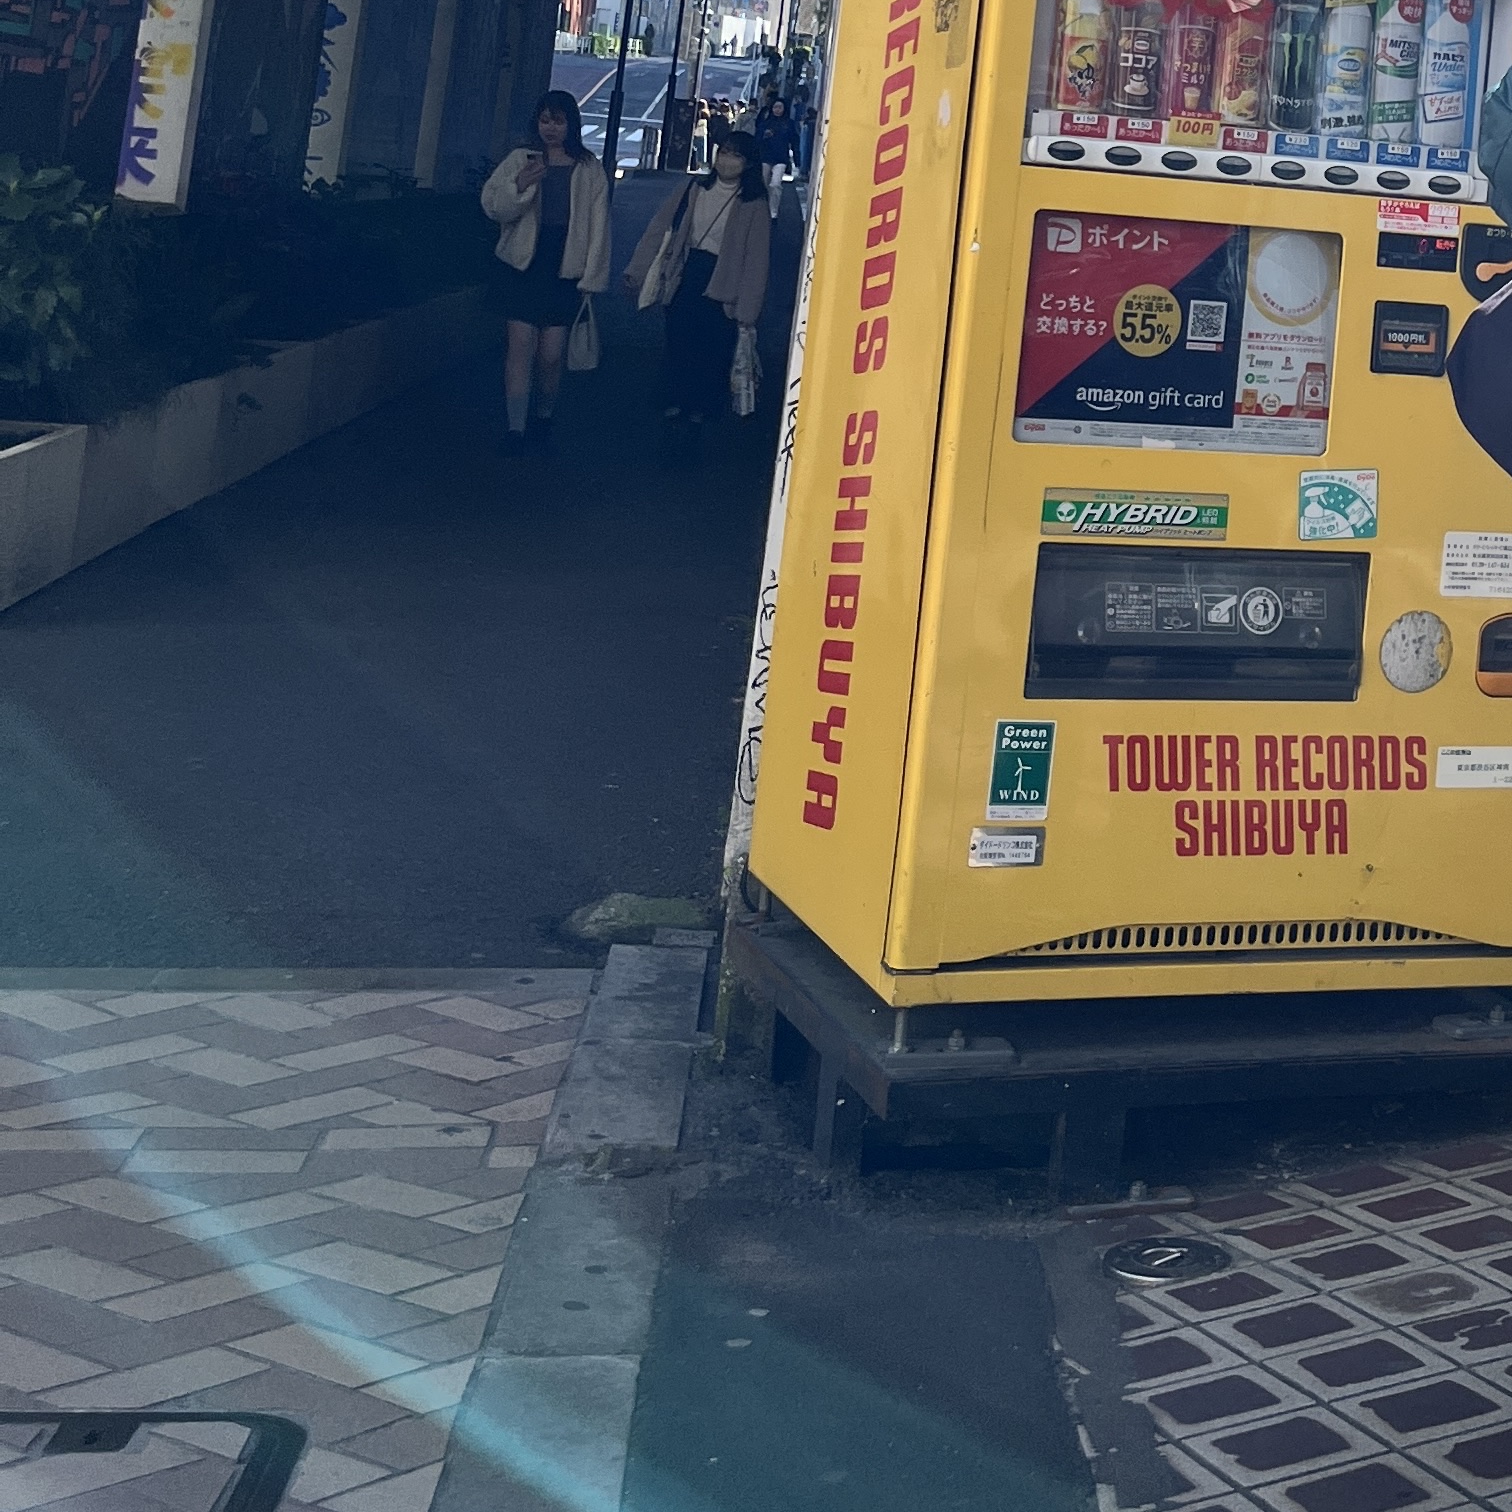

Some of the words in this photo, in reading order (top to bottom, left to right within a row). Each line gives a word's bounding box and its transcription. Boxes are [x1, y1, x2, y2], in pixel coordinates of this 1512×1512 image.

[1119, 52, 1158, 70] ココア
[1181, 74, 1205, 85] ミルク
[1175, 119, 1215, 136] 100円
[1087, 224, 1169, 252] ポイント
[1039, 292, 1096, 314] どっちと
[1124, 300, 1174, 314] 最大還元率
[1036, 316, 1108, 337] 交換する?
[1119, 312, 1172, 346] 5.5%
[1387, 332, 1427, 344] 1000円札
[1076, 386, 1144, 405] amazon
[1148, 387, 1181, 411] gift
[1183, 389, 1224, 409] card
[1072, 502, 1198, 532] HYBRID
[1201, 508, 1219, 517] LED
[1081, 523, 1118, 534] HEAT
[1116, 526, 1154, 536] PUMP
[802, 410, 878, 830] SHIBUYA
[1004, 725, 1047, 738] Green
[1001, 737, 1048, 750] Power
[1102, 734, 1240, 793] TOWER
[1255, 734, 1427, 792] RECORDS
[999, 789, 1040, 801] WIND
[1174, 798, 1349, 857] SHIBUYA
